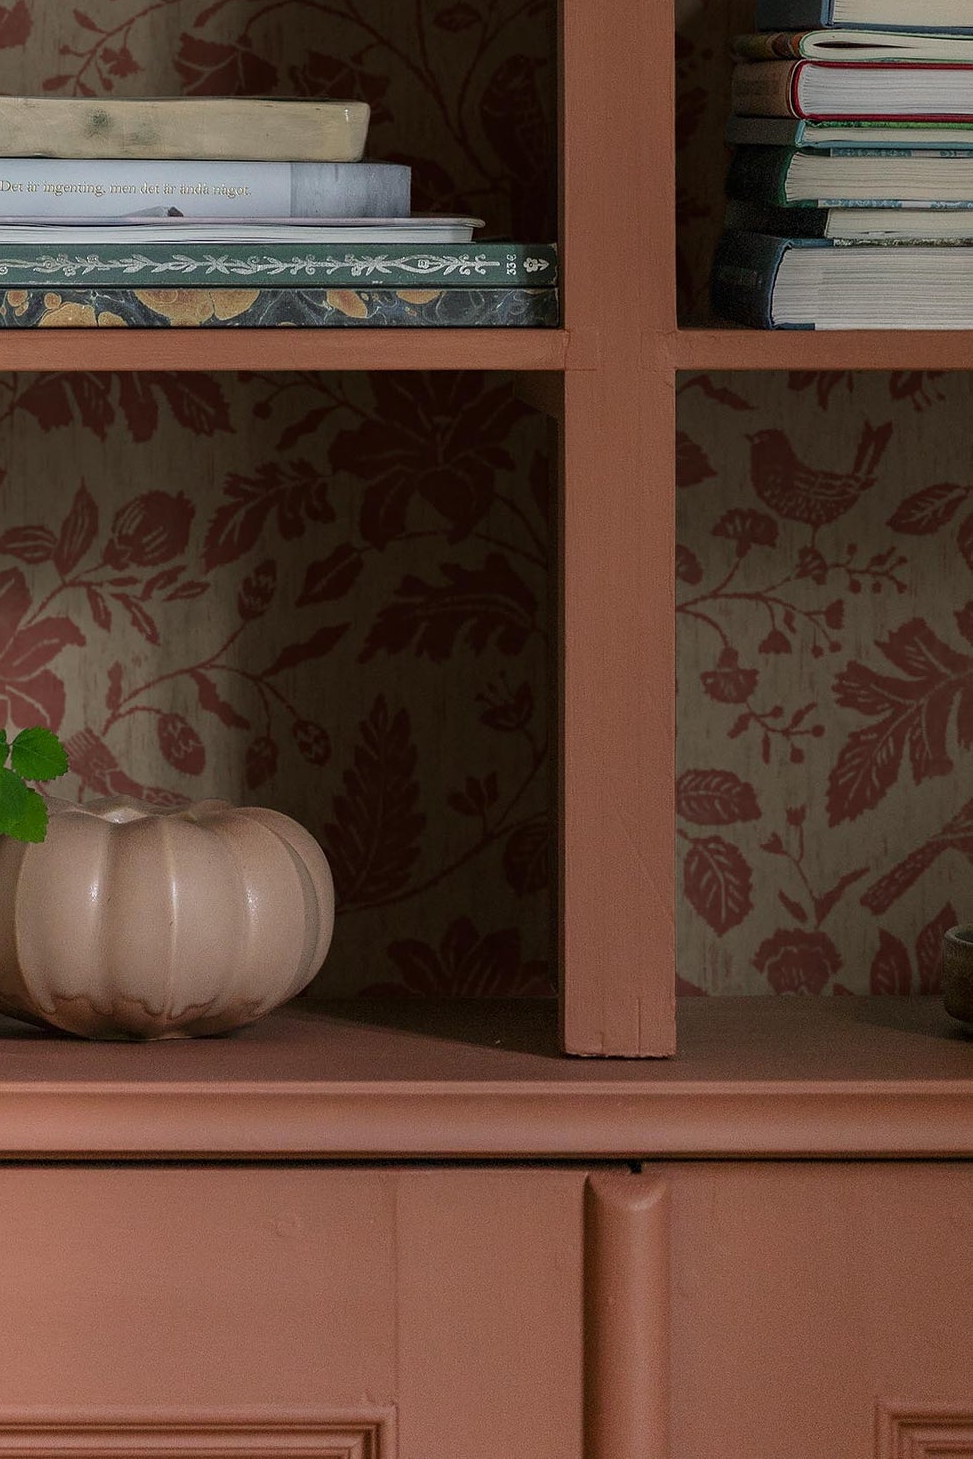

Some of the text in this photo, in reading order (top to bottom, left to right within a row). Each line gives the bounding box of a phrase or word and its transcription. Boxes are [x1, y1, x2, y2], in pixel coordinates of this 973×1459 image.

[0, 179, 23, 192] Det
[26, 180, 40, 192] är
[110, 184, 136, 194] men
[140, 181, 160, 195] det
[163, 182, 177, 195] är
